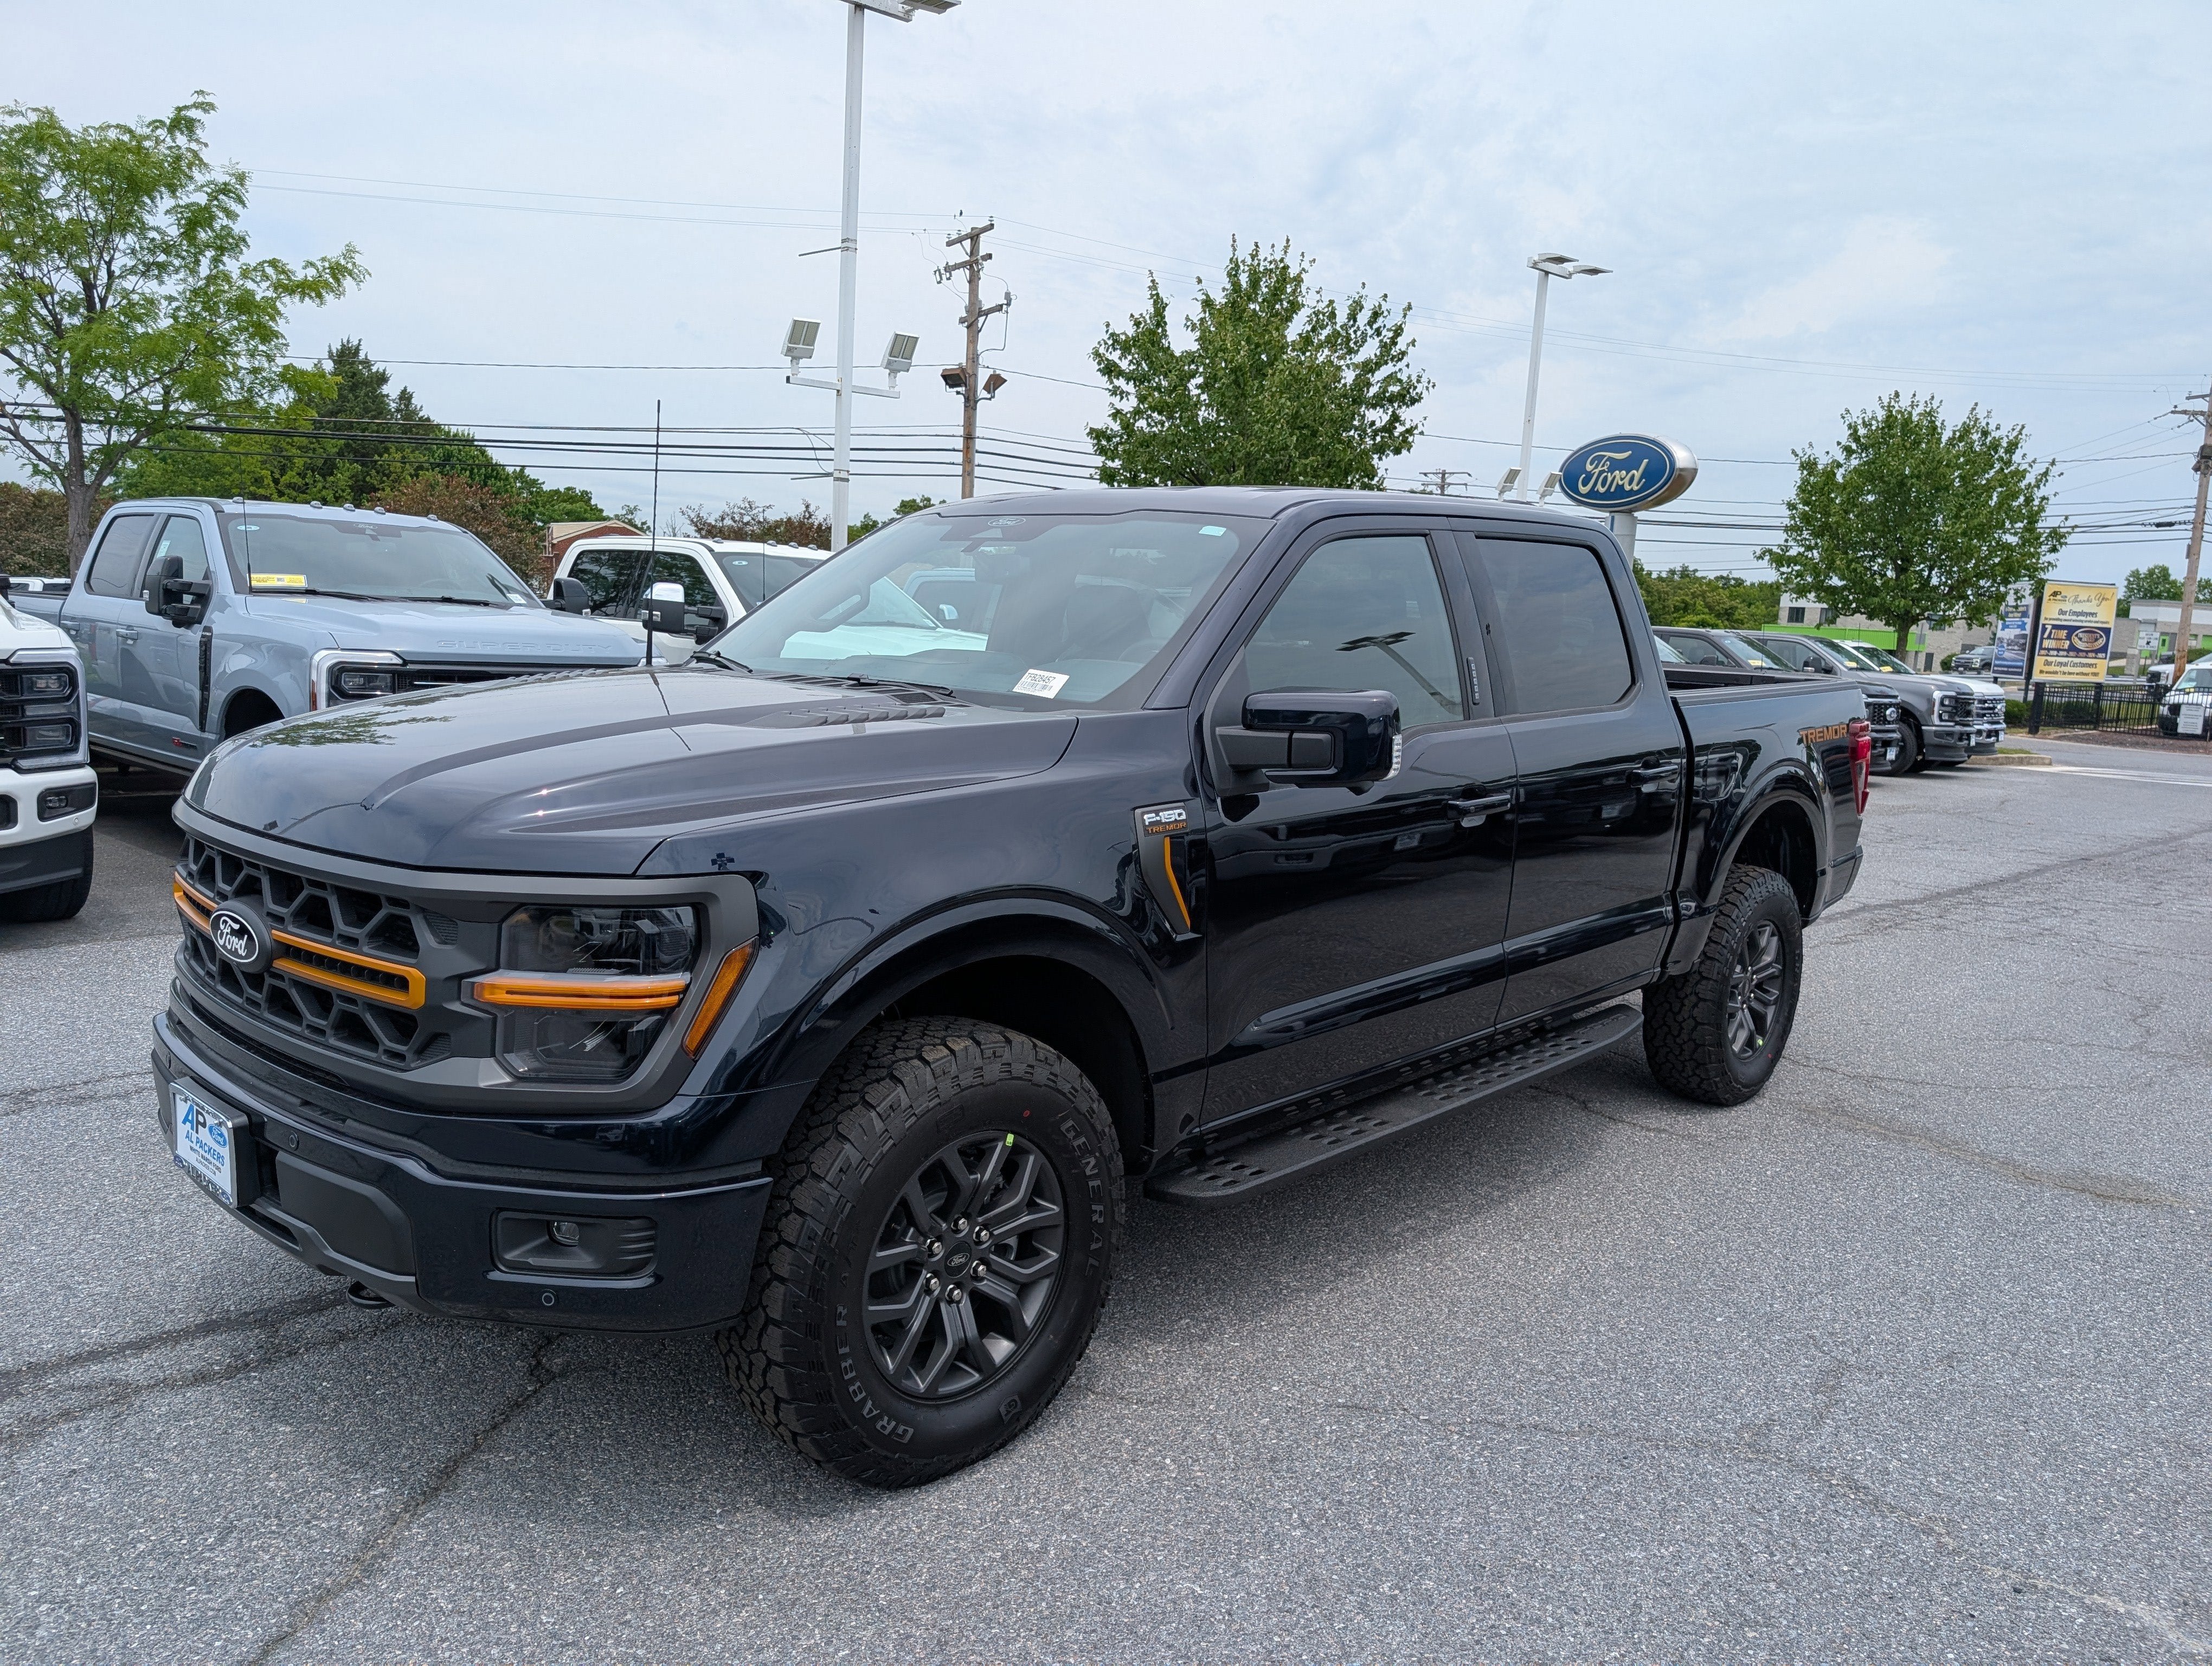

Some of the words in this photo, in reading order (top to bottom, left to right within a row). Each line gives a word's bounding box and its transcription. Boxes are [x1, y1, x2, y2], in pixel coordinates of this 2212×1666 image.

[1578, 451, 1649, 494] Ford
[2057, 608, 2067, 616] Our
[2068, 608, 2098, 619] Employees
[2043, 625, 2052, 638] 7
[2051, 629, 2068, 639] TIME
[437, 640, 542, 652] SUPER
[545, 643, 612, 653] DUTY
[2042, 639, 2070, 650] WINNER
[2054, 659, 2069, 668] Loyal
[2069, 661, 2098, 669] Customers
[1024, 672, 1056, 684] TFB28457
[1798, 724, 1847, 746] TREMOR
[1143, 809, 1186, 825] F-150
[1147, 822, 1187, 834] TREMOR
[218, 916, 248, 957] Ford
[181, 1103, 207, 1136] AP
[212, 1126, 224, 1146] Ford
[185, 1129, 194, 1144] AL
[195, 1137, 226, 1168] PACKERS
[189, 1145, 201, 1158] WHITE
[213, 1162, 222, 1174] FORD
[1060, 1118, 1105, 1276] GENERAL
[951, 1255, 966, 1265] Ford
[836, 1303, 915, 1444] GRABBER
